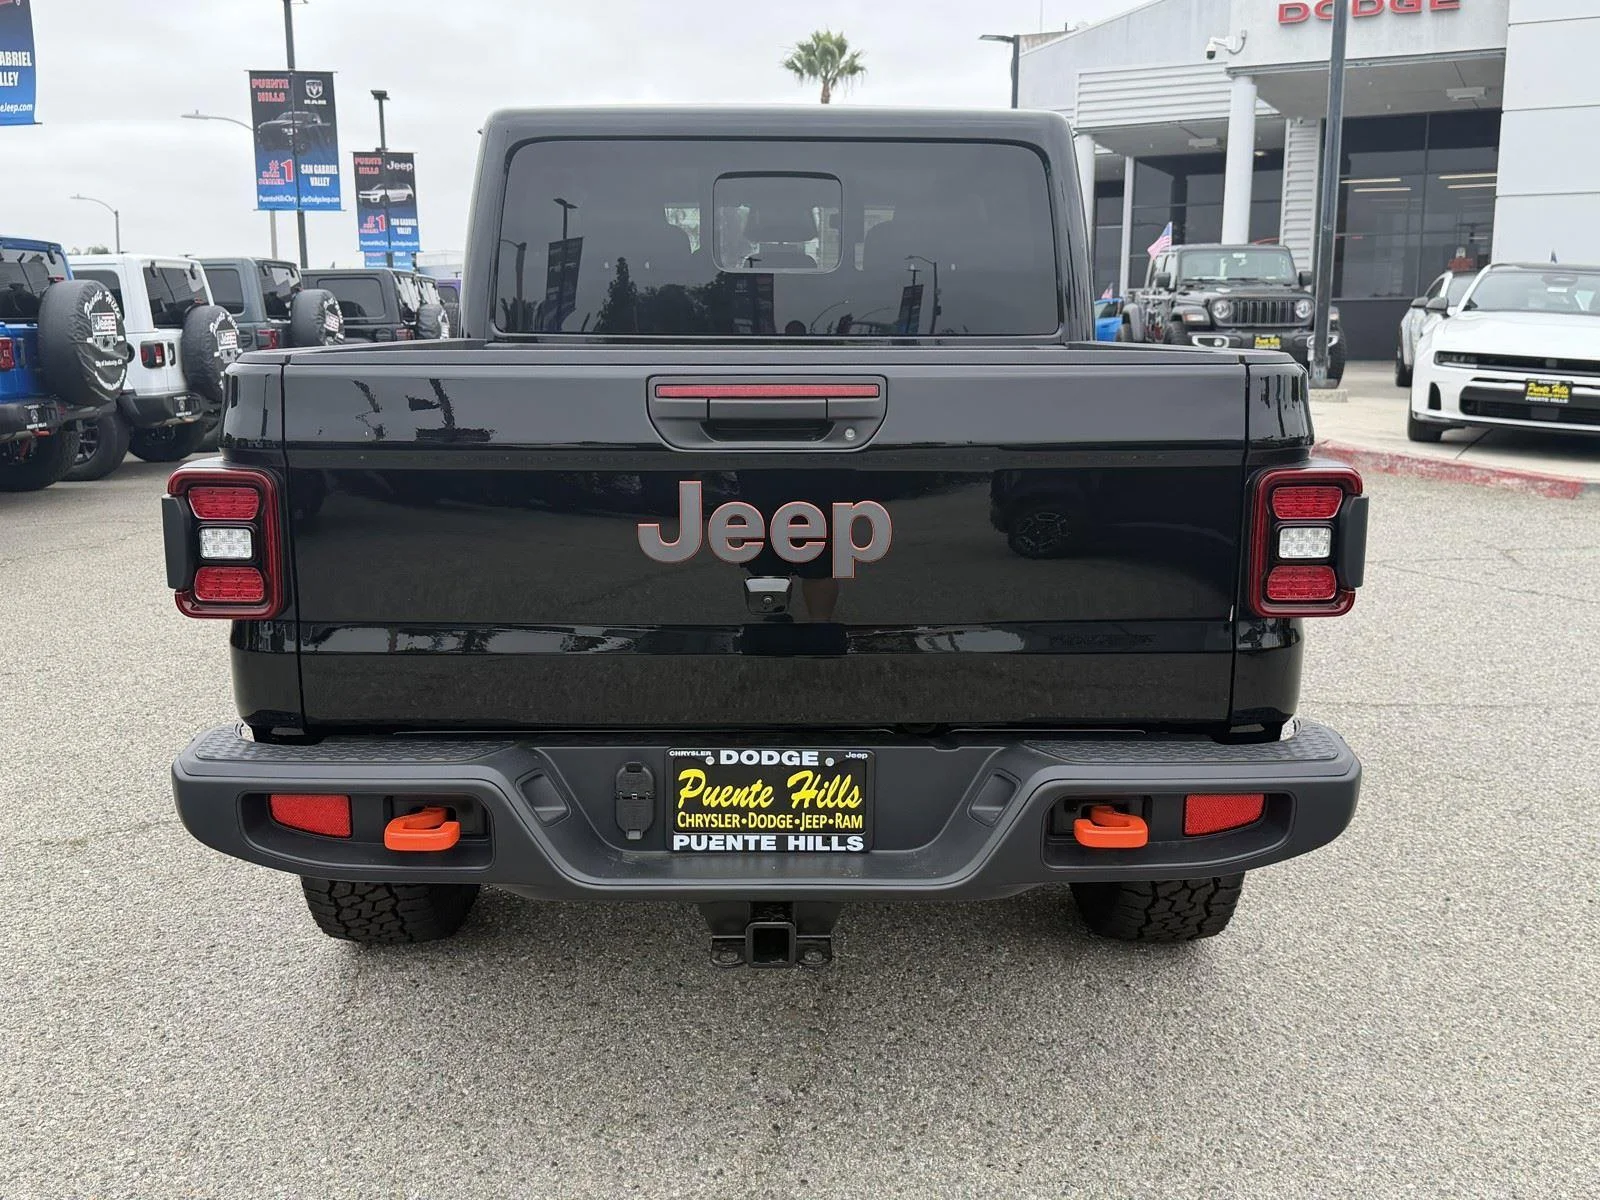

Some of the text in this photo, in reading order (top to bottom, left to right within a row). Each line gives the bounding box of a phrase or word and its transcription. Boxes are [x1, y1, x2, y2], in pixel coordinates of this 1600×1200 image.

[1278, 0, 1461, 24] DODGE
[0, 51, 32, 67] ABRIEL
[0, 71, 19, 87] LLEY
[251, 78, 290, 89] PUENTE
[257, 92, 286, 103] HILLS
[268, 158, 294, 183] #1
[386, 160, 413, 172] Jeep
[309, 176, 330, 187] VALLEY
[638, 480, 893, 579] Jeep
[719, 750, 819, 766] DODGE
[678, 768, 863, 809] Puente Hills
[673, 834, 864, 851] PUENTE HILLS
